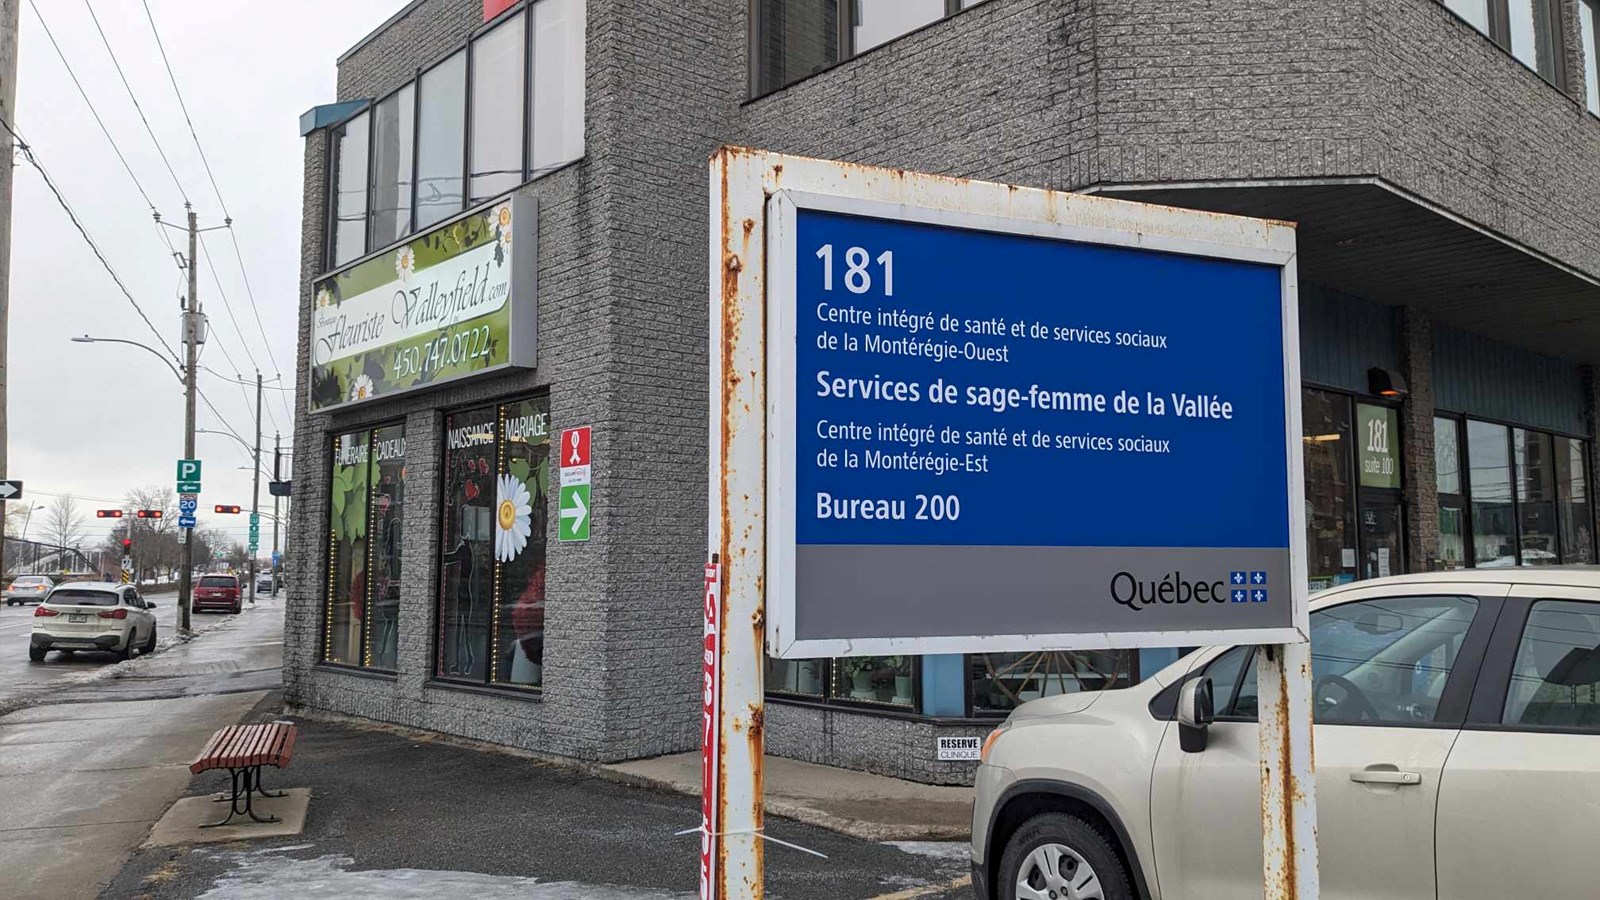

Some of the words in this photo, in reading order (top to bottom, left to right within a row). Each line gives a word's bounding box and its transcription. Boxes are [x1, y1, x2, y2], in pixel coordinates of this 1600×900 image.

[816, 244, 893, 297] 181
[315, 311, 385, 366] Fleuriste
[817, 302, 872, 325] Centre
[877, 310, 935, 334] intégré
[940, 314, 959, 332] de
[965, 318, 1006, 336] santé
[1012, 321, 1026, 338] et
[1031, 322, 1049, 340] de
[1054, 326, 1111, 345] services
[1116, 330, 1167, 349] sociaux
[393, 325, 490, 379] 450.747.0722
[817, 331, 838, 350] de
[844, 333, 858, 352] la
[865, 334, 1009, 363] Montérégie-Ouest
[816, 370, 920, 402] Services
[929, 379, 958, 404] de
[966, 385, 1106, 412] sage-femme
[1114, 390, 1140, 415] de
[1147, 392, 1165, 416] la
[1171, 393, 1233, 420] Vallée
[448, 422, 495, 450] NAISSANCE
[505, 413, 548, 441] MARIAGE
[817, 419, 872, 441] Centre
[878, 423, 935, 447] intégré
[941, 426, 960, 444] de
[965, 428, 1008, 446] santé
[1013, 430, 1027, 447] et
[1032, 431, 1051, 448] de
[1056, 433, 1114, 451] services
[1118, 436, 1170, 453] sociaux
[1367, 419, 1389, 453] 181
[182, 463, 196, 479] P
[817, 449, 838, 467] de
[844, 450, 858, 468] la
[865, 450, 989, 476] Montérégie-Est
[1364, 456, 1381, 474] suite
[1381, 457, 1394, 475] 100
[181, 501, 196, 509] 20
[816, 492, 906, 520] Bureau
[915, 494, 960, 521] 200
[1110, 571, 1226, 611] Québec
[940, 751, 978, 759] CLINIQUE
[941, 739, 978, 749] RESERVE
